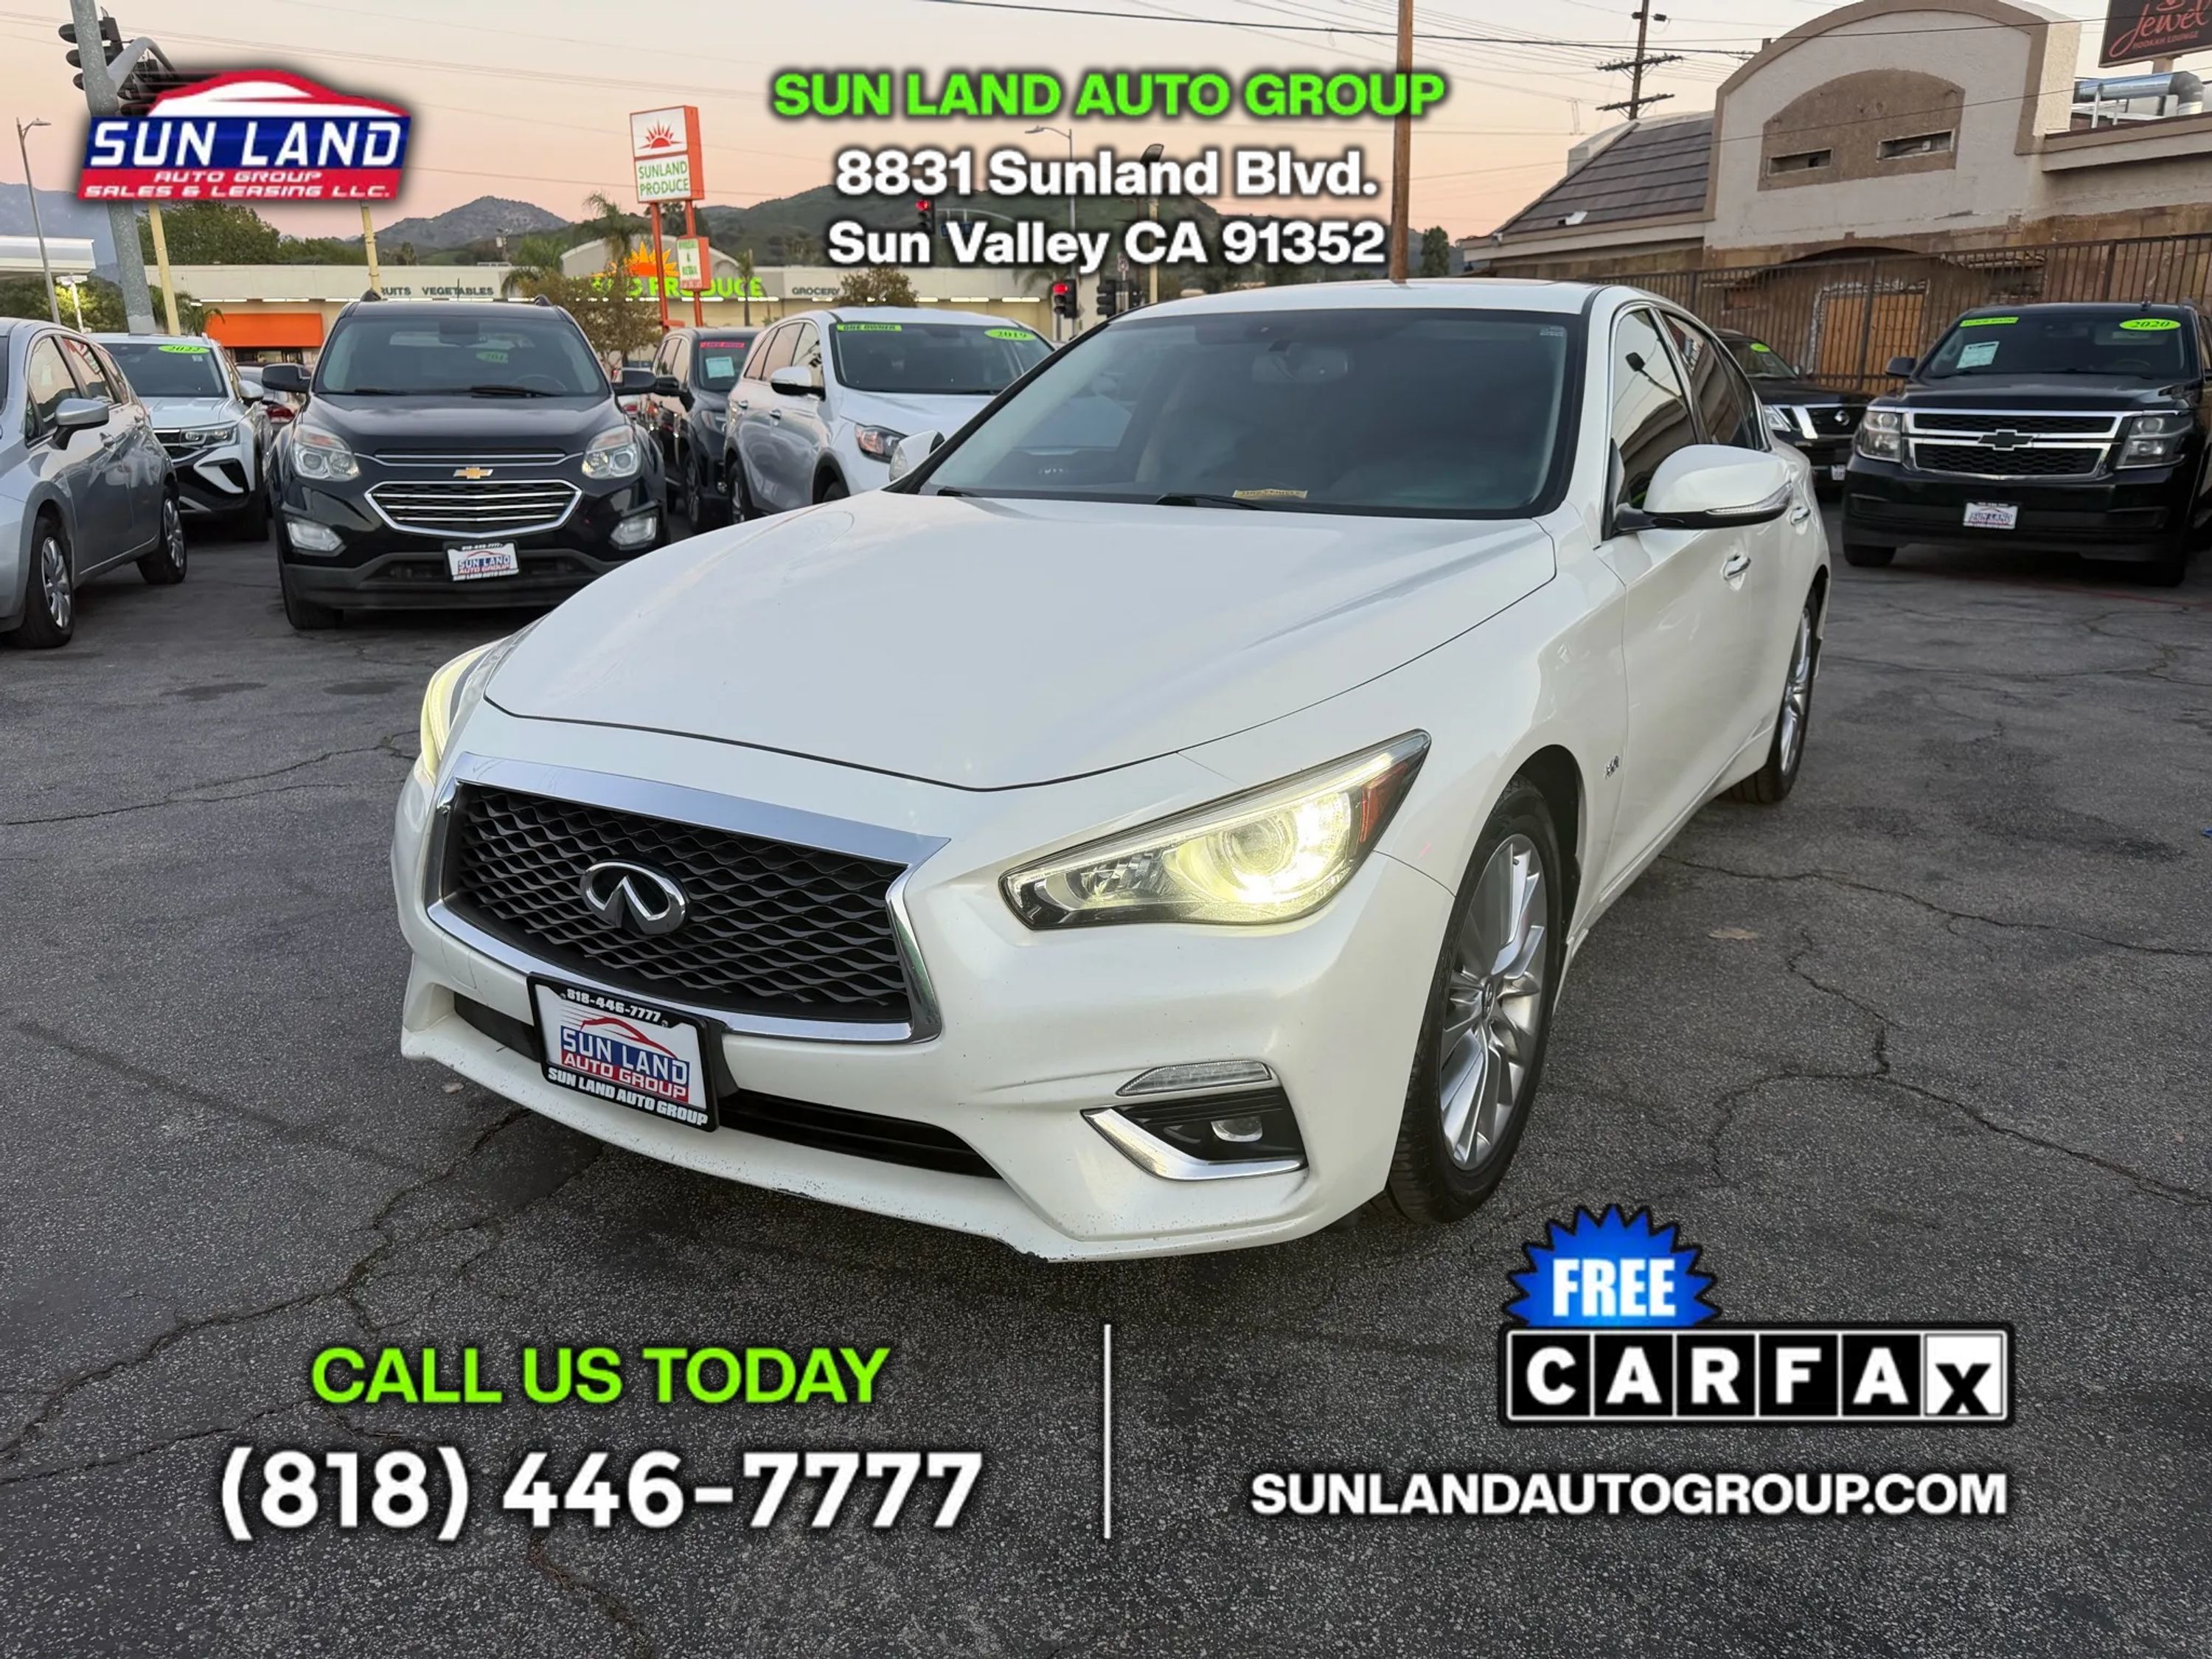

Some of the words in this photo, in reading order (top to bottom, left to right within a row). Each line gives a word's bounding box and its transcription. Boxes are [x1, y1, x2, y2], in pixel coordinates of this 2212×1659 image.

[639, 161, 688, 179] SUNLAND
[640, 178, 689, 196] PRODUCE
[422, 286, 494, 296] VEGETABLES
[648, 276, 763, 298] PRDUCE
[792, 286, 841, 296] GROCERY
[458, 558, 479, 568] SUN
[483, 556, 510, 566] LAND
[566, 988, 661, 1022] 818-446-7777
[563, 1029, 612, 1062] SUN
[622, 1045, 688, 1086] LAND
[564, 1053, 613, 1078] AUTO
[619, 1069, 686, 1099] GROUP
[548, 1067, 576, 1088] SUN
[578, 1075, 616, 1099] LAND
[616, 1090, 655, 1111] AUTO
[656, 1102, 709, 1126] GROUP
